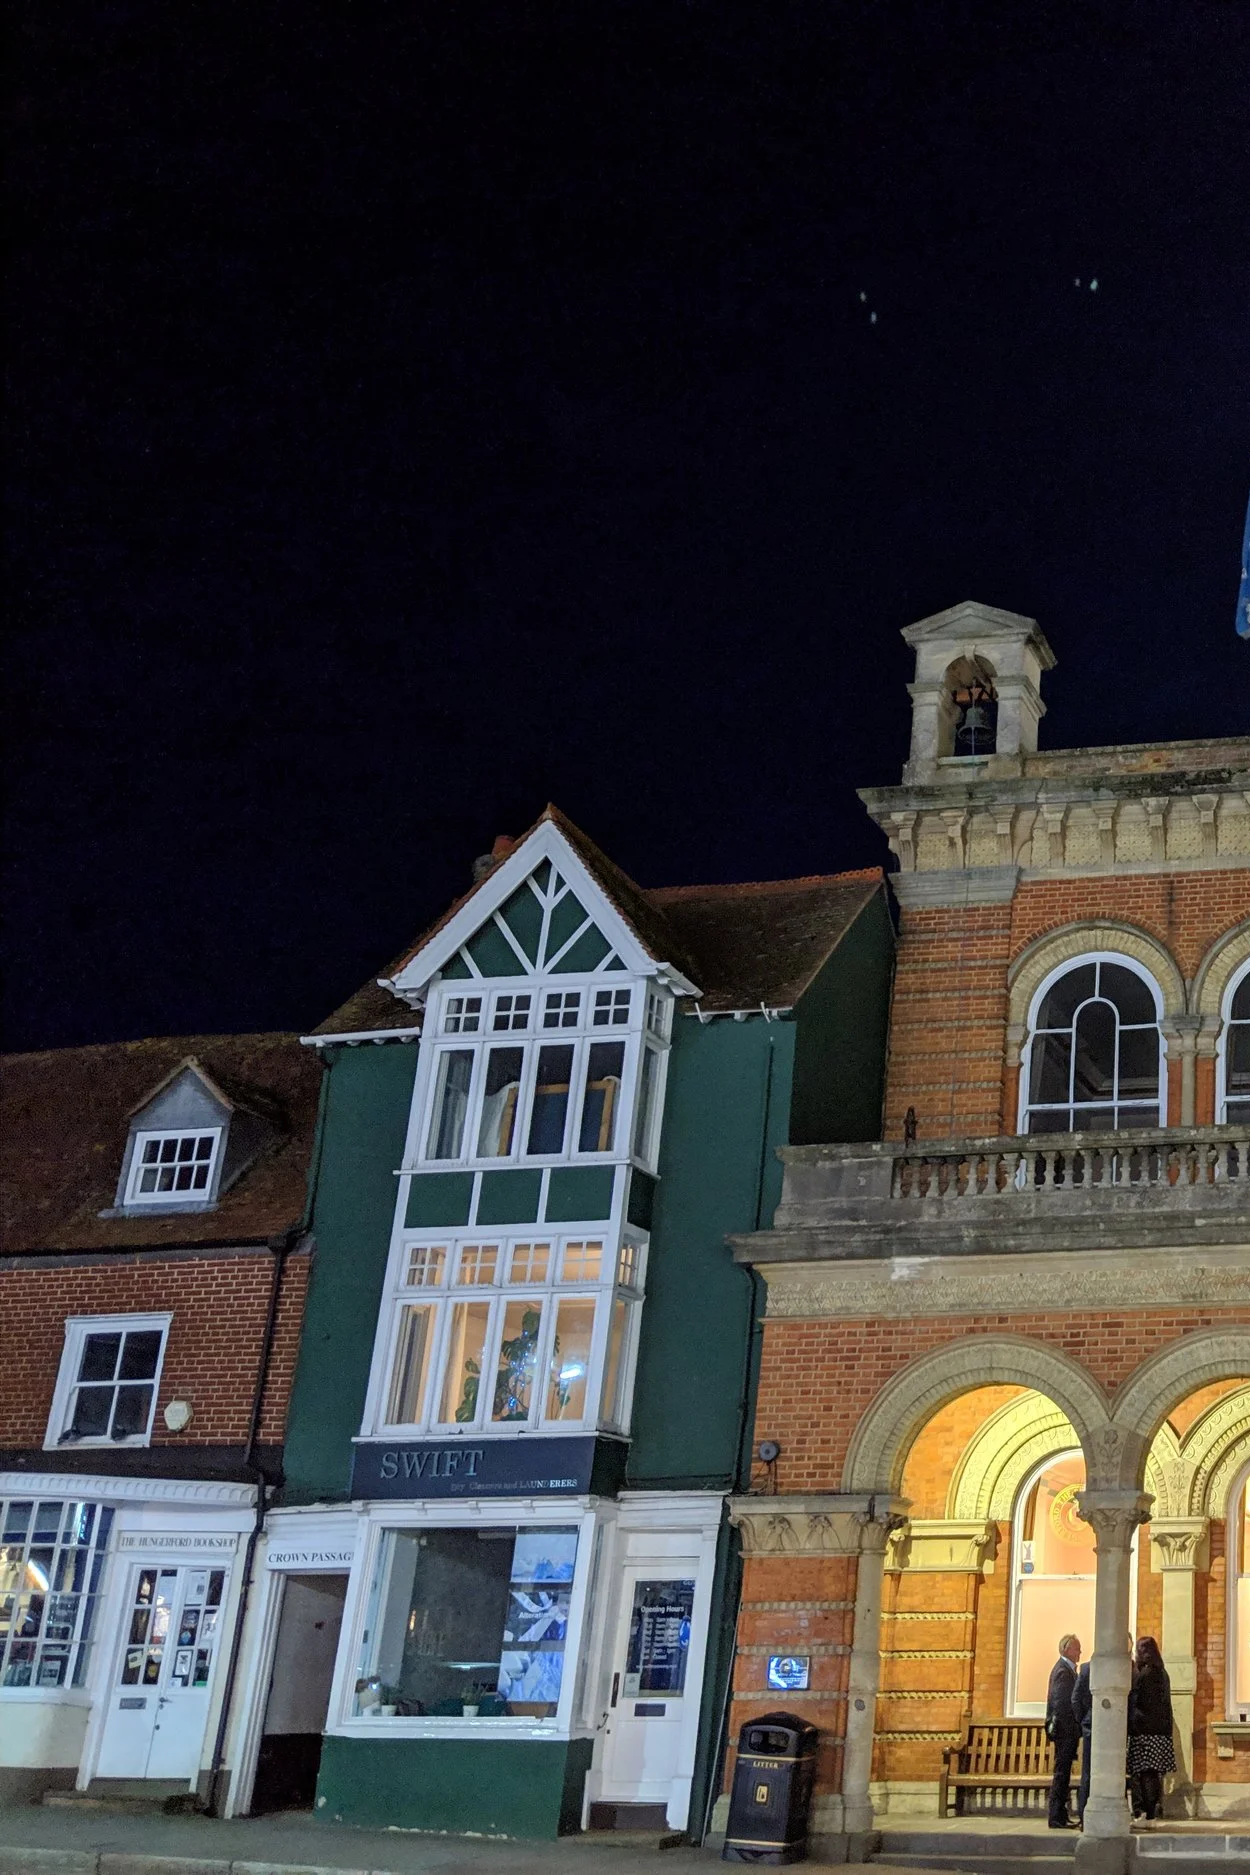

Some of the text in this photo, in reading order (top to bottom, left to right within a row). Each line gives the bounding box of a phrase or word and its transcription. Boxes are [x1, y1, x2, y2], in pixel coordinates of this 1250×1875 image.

[380, 1450, 484, 1479] SWIFT
[519, 1478, 578, 1489] LAUNDERERS
[121, 1537, 236, 1548] THE HUNGERFORD BOOKSHOP
[268, 1553, 308, 1563] CROWN
[641, 1605, 685, 1614] Opening Hours
[752, 1761, 779, 1769] LITTER
